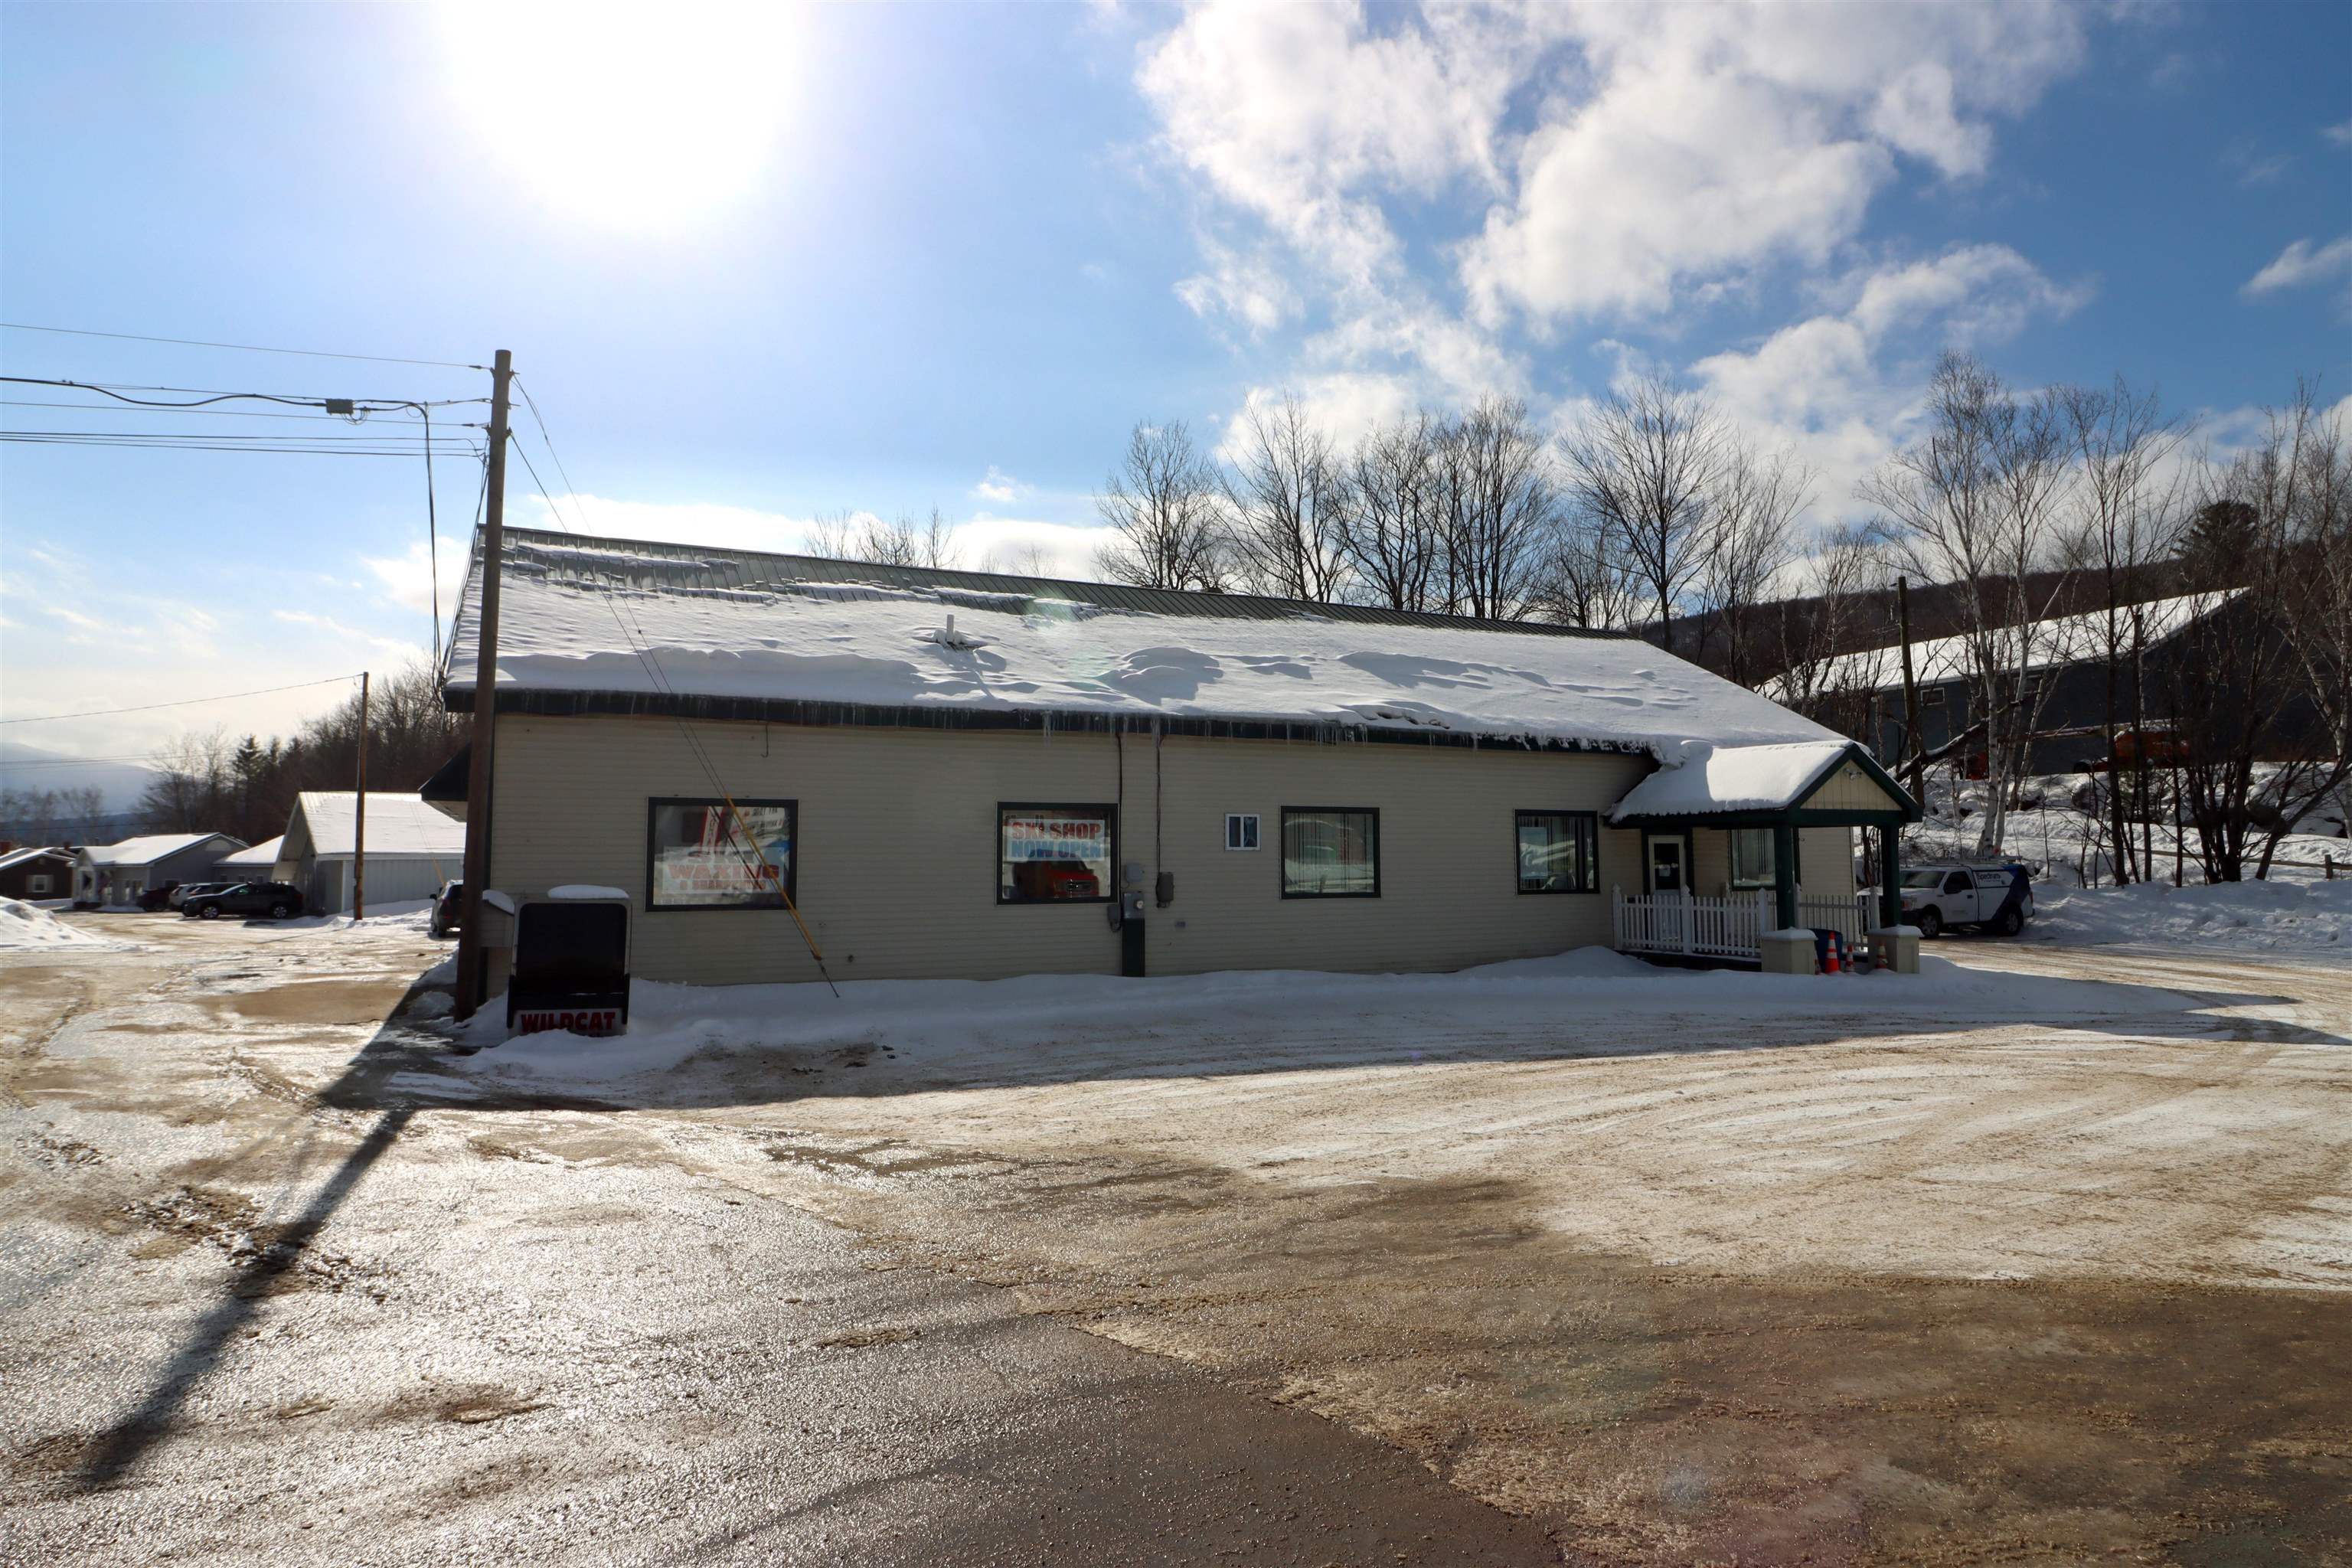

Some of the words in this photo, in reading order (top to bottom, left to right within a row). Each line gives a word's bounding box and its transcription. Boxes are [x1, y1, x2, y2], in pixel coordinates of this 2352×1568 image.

[1012, 822, 1044, 840] SKI
[1050, 822, 1102, 840] SHOP
[1011, 840, 1054, 858] NOW
[1058, 840, 1101, 858] OPEN
[668, 864, 779, 879] WAXING
[521, 1011, 616, 1033] WILDCAT
